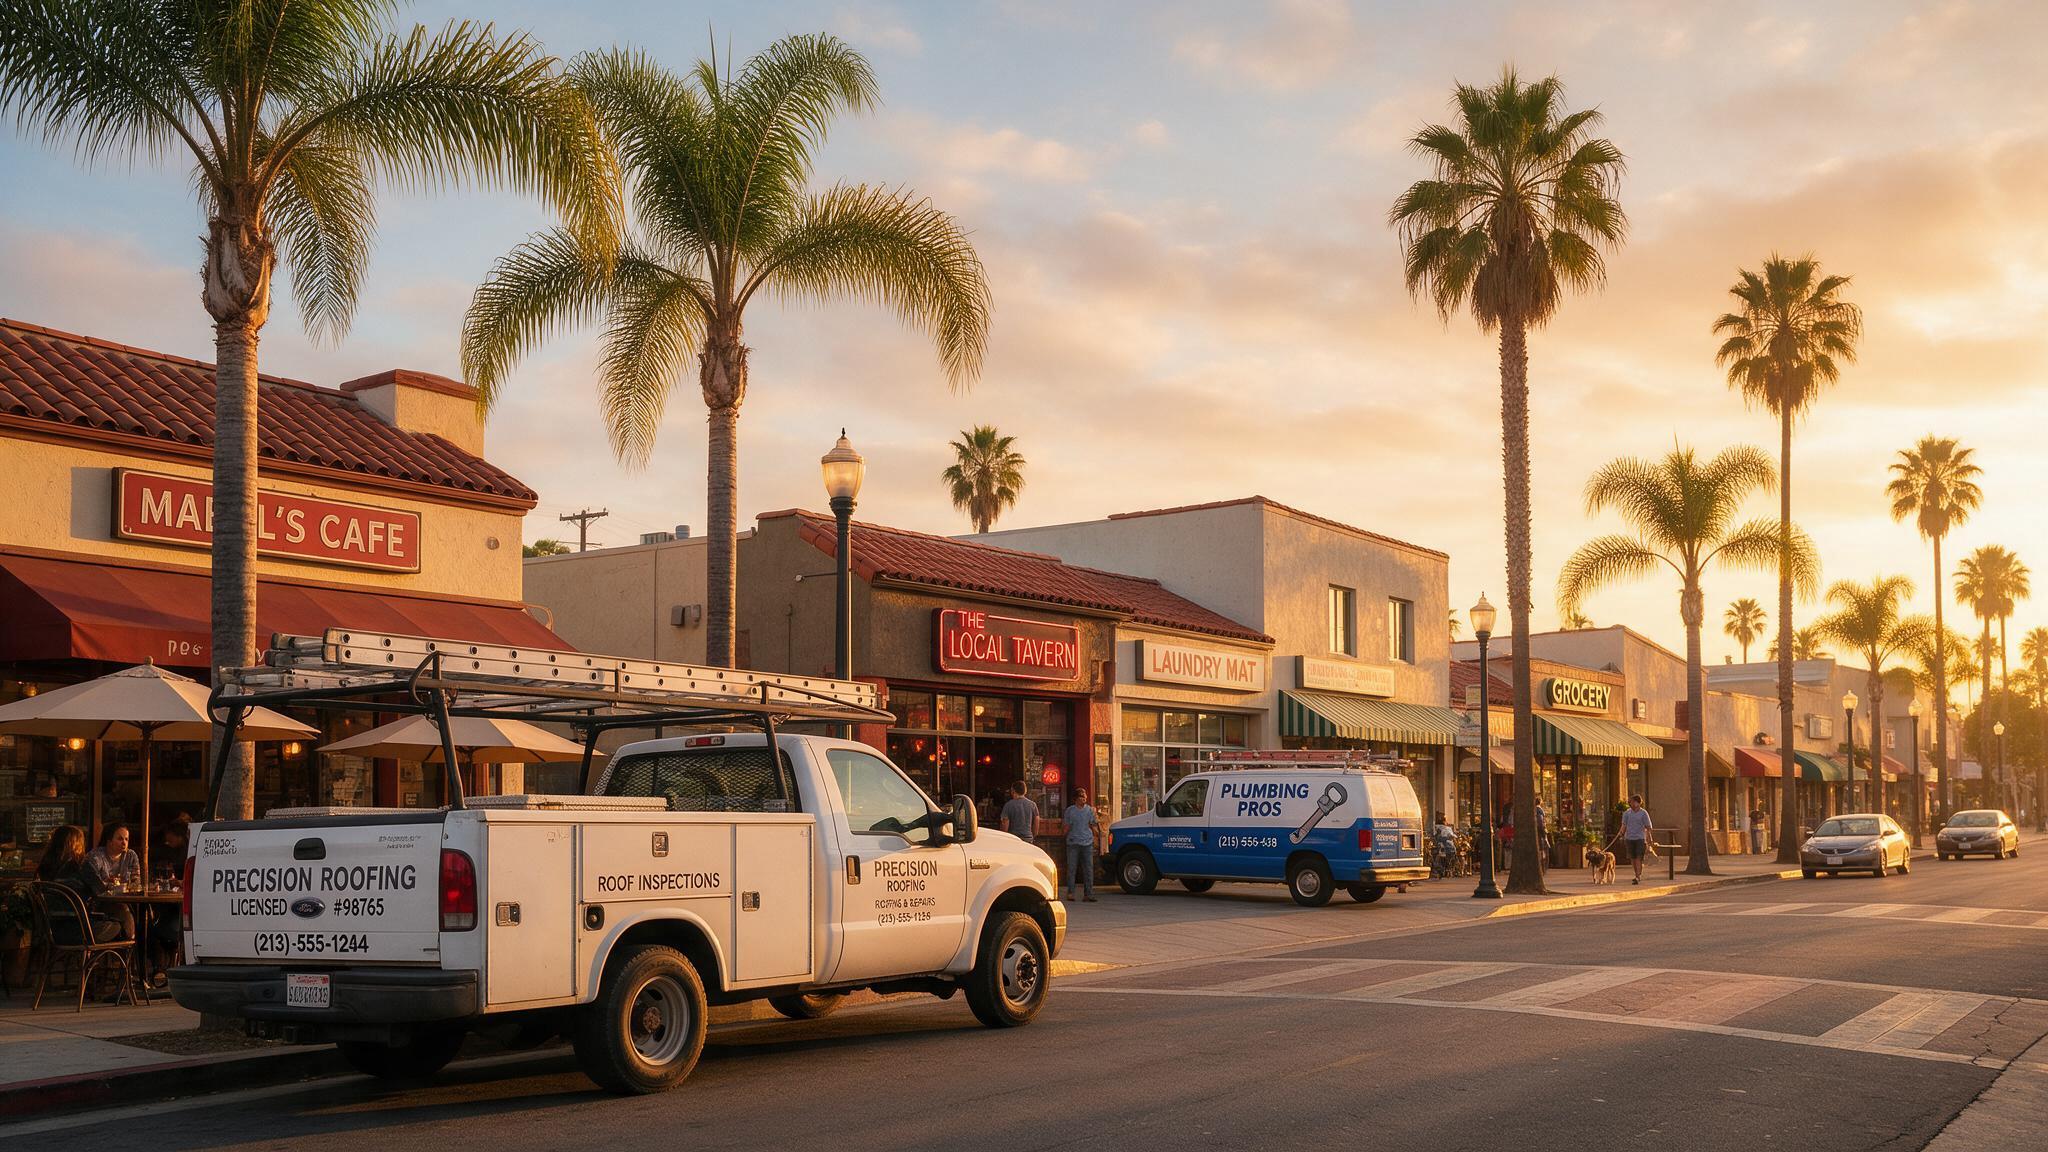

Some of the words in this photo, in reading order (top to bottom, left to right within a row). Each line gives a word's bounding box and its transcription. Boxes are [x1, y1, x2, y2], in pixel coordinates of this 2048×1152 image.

[141, 487, 306, 543] MAL'S
[320, 514, 404, 557] CAFE
[958, 611, 985, 628] THE
[951, 630, 1008, 662] LOCAL
[1012, 637, 1075, 668] TAVERN
[1153, 649, 1222, 679] LAUNDRY
[1226, 658, 1257, 683] MAT
[1553, 678, 1611, 710] GROCERY
[1221, 783, 1309, 799] PLUMBING
[1238, 801, 1282, 817] PROS
[212, 867, 312, 892] PRECISION
[320, 865, 416, 891] ROOFING
[874, 860, 938, 877] PRECISION
[598, 875, 634, 892] ROOF
[638, 872, 720, 890] INSPECTIONS
[887, 880, 926, 892] ROOFING
[231, 898, 287, 916] LICENSED
[334, 898, 384, 916] #98765
[254, 933, 369, 956] (213)-555-1244
